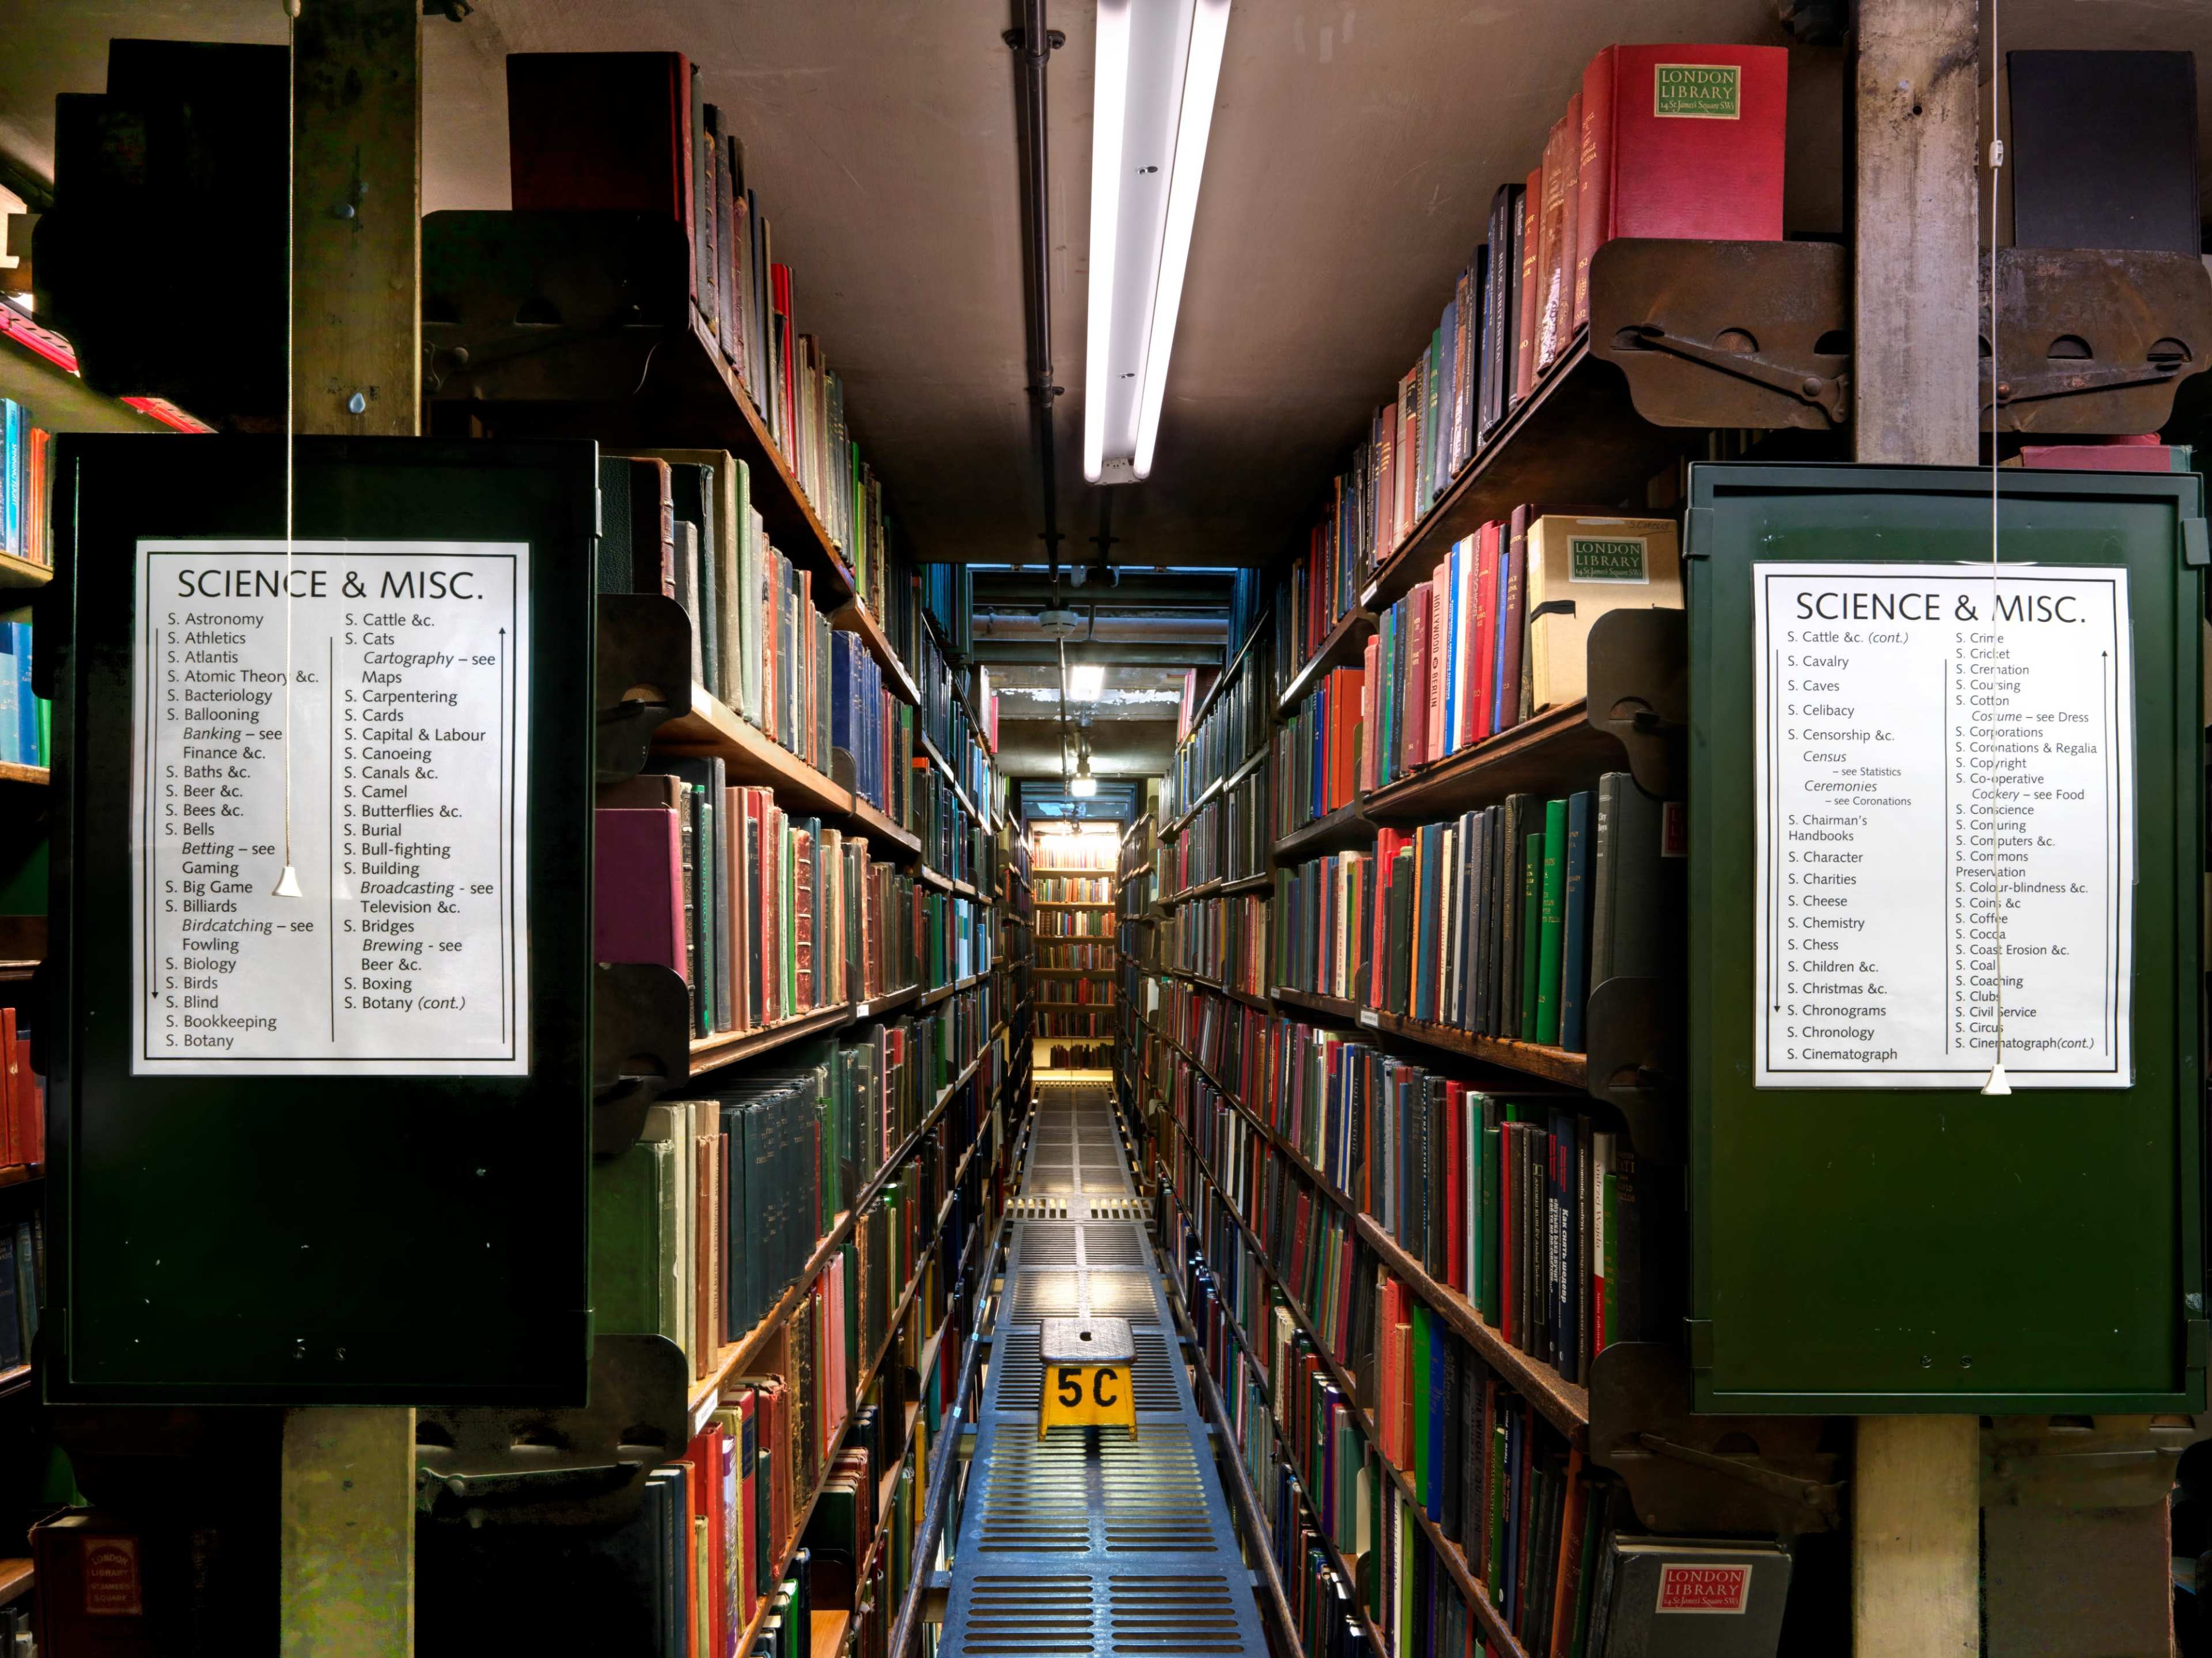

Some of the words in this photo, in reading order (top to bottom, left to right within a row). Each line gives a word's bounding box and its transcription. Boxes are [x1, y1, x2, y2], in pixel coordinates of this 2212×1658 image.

[1662, 70, 1734, 84] LONDON
[1661, 85, 1733, 99] LIBRARY
[1698, 101, 1719, 113] Square
[1575, 543, 1640, 554] LONDON
[1575, 555, 1639, 567] LIBRARY
[177, 569, 327, 598] SCIENCE
[342, 570, 368, 599] &
[380, 571, 483, 600] MISC.
[1797, 592, 1941, 621] SCIENCE
[1955, 594, 1979, 622] &
[1991, 595, 2085, 623] MISC.
[184, 612, 264, 629] Astronomy
[363, 612, 406, 626] Cattle
[411, 614, 435, 627] &c.
[1433, 594, 1441, 654] HOLLYWOOD
[184, 630, 246, 645] Athletics
[362, 632, 395, 645] Cats
[1802, 631, 1839, 643] Cattle
[1843, 631, 1863, 643] &c.
[1868, 631, 1908, 645] (cont.)
[184, 649, 238, 664] Atlantis
[363, 651, 454, 668] Cartography
[472, 655, 496, 666] see
[1802, 655, 1849, 670] Cavalry
[184, 669, 236, 683] Atomic
[239, 669, 287, 686] Theory
[296, 670, 319, 683] &c.
[362, 670, 402, 687] Maps
[1431, 672, 1439, 707] BERLIN
[1802, 680, 1840, 691] Caves
[185, 688, 273, 706] Bacteriology
[362, 689, 458, 707] Carpentering
[1970, 695, 2009, 706] Cotton
[184, 707, 260, 725] Ballooning
[362, 708, 404, 722] Cards
[1802, 704, 1855, 719] Celibacy
[183, 726, 243, 744] Banking
[259, 730, 283, 740] see
[362, 727, 413, 745] Capital
[418, 728, 430, 741] &
[435, 728, 486, 741] Labour
[1803, 728, 1870, 744] Censorship
[1875, 729, 1895, 741] &c.
[183, 746, 238, 759] Finance
[242, 746, 266, 759] &c.
[362, 747, 432, 764] Canoeing
[1969, 741, 2039, 753] Coronations
[2043, 743, 2052, 754] &
[2056, 742, 2097, 756] Regalia
[1803, 751, 1847, 762] Census
[184, 764, 223, 778] Baths
[228, 765, 251, 778] &c.
[362, 765, 410, 779] Canals
[415, 766, 438, 779] &c.
[1860, 767, 1902, 777] Statistics
[1804, 779, 1877, 792] Ceremonies
[1970, 773, 2044, 787] Co-operative
[184, 784, 215, 797] Beer
[220, 785, 243, 797] &c.
[362, 784, 407, 798] Camel
[2033, 791, 2052, 800] see
[2056, 789, 2085, 800] Food
[1853, 796, 1911, 806] Coronations
[183, 803, 216, 816] Bees
[221, 804, 244, 817] &c.
[362, 804, 434, 817] Butterflies
[439, 805, 463, 818] &c.
[1802, 814, 1868, 826] Chairman's
[183, 822, 215, 836] Bells
[362, 823, 402, 836] Burial
[1789, 830, 1854, 841] Handbooks
[181, 842, 235, 858] Betting
[252, 845, 275, 855] see
[362, 842, 452, 860] Bull-fighting
[1803, 850, 1863, 863] Character
[181, 861, 240, 878] Gaming
[362, 861, 420, 879] Building
[1956, 866, 2025, 878] Preservation
[1803, 872, 1857, 885] Charities
[183, 880, 206, 897] Big
[210, 880, 253, 894] Game
[360, 880, 455, 898] Broadcasting
[470, 884, 494, 895] see
[183, 899, 237, 913] Billiards
[359, 899, 431, 913] Television
[437, 900, 460, 914] &c.
[1803, 894, 1848, 907] Cheese
[181, 918, 274, 936] Birdcatching
[290, 922, 314, 932] see
[362, 918, 415, 936] Bridges
[1802, 916, 1865, 932] Chemistry
[183, 937, 240, 955] Fowling
[362, 938, 424, 956] Brewing
[438, 941, 463, 952] see
[1802, 938, 1839, 951] Chess
[2006, 944, 2047, 955] Erosion
[2051, 945, 2070, 955] &c.
[184, 956, 237, 974] Biology
[361, 957, 394, 971] Beer
[398, 958, 422, 971] &c.
[1802, 960, 1854, 972] Children
[1859, 961, 1878, 972] &c.
[1969, 959, 1996, 971] Coal
[184, 975, 218, 990] Birds
[362, 976, 412, 994] Boxing
[1802, 982, 1863, 994] Christmas
[1867, 983, 1888, 994] &c.
[184, 995, 218, 1009] Blind
[362, 996, 414, 1013] Botany
[418, 995, 465, 1011] (cont.)
[1802, 1004, 1887, 1019] Chronograms
[1969, 1006, 1994, 1017] Civil
[184, 1013, 277, 1032] Bookkeeping
[1802, 1025, 1875, 1042] Chronology
[184, 1034, 234, 1051] Botany
[1802, 1047, 1897, 1063] Cinematograph
[93, 1554, 128, 1565] LONDON
[1668, 1571, 1742, 1582] LONDON
[1666, 1585, 1738, 1595] LIBRARY
